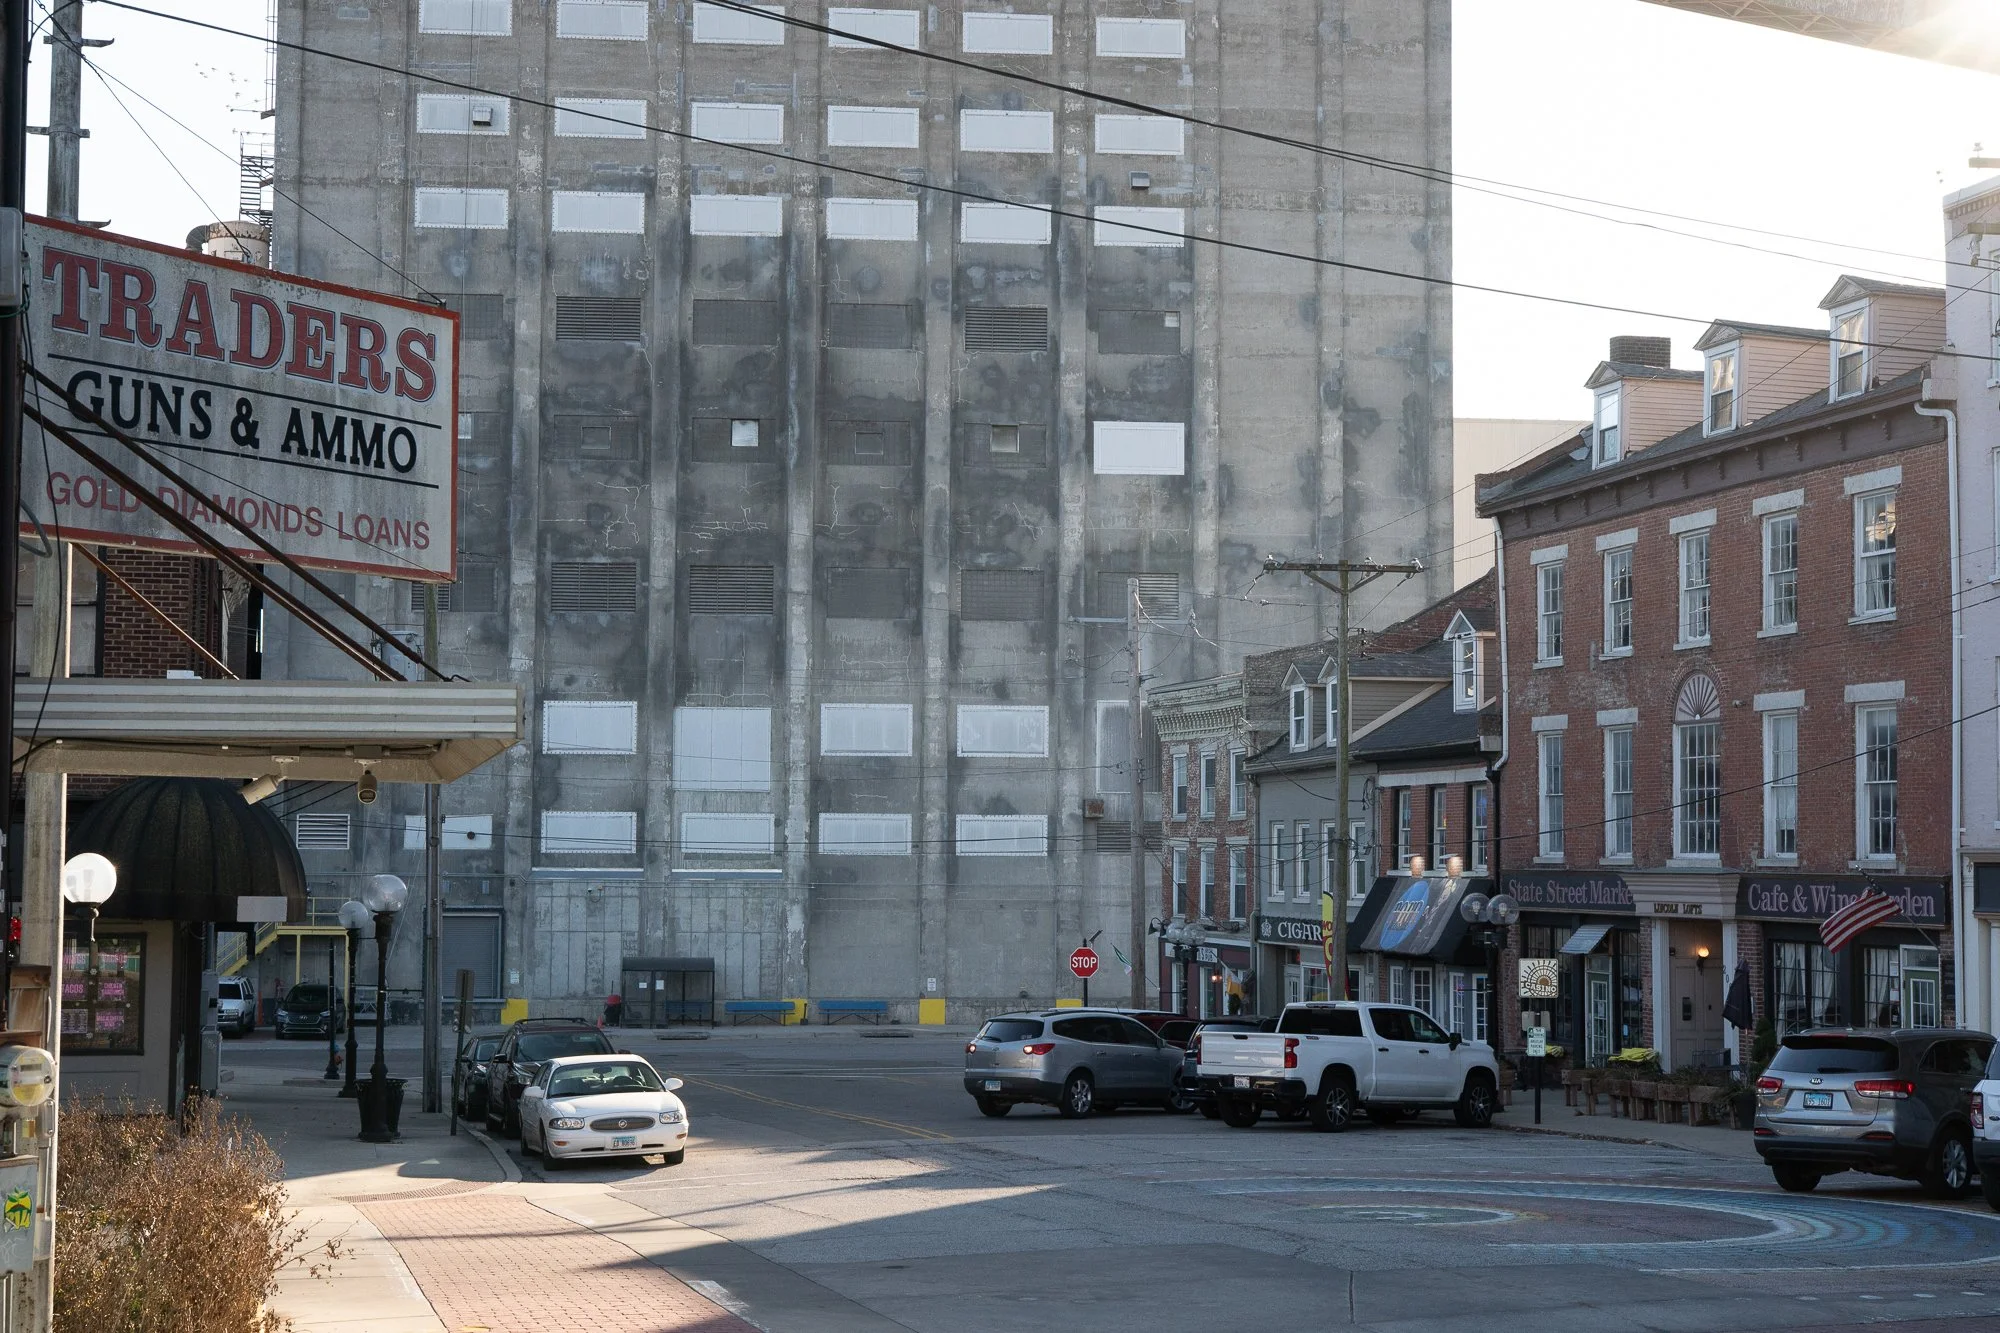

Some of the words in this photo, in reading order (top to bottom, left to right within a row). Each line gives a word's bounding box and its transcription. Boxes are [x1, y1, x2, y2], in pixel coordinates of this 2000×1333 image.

[42, 246, 436, 402] TRADERS
[66, 370, 212, 440] GUNS
[230, 397, 260, 449] &
[281, 407, 417, 473] AMMO
[46, 472, 143, 513] GOLD
[158, 487, 324, 537] DIAMONDS
[338, 512, 430, 550] LOANS
[1508, 879, 1543, 903] State
[1546, 880, 1588, 904] Street
[1589, 881, 1634, 905] Marke
[1747, 883, 1789, 912] Cafe
[1791, 884, 1808, 913] &
[1683, 903, 1703, 915] LOFTS
[1071, 956, 1097, 968] STOP
[1525, 981, 1557, 993] CASINO
